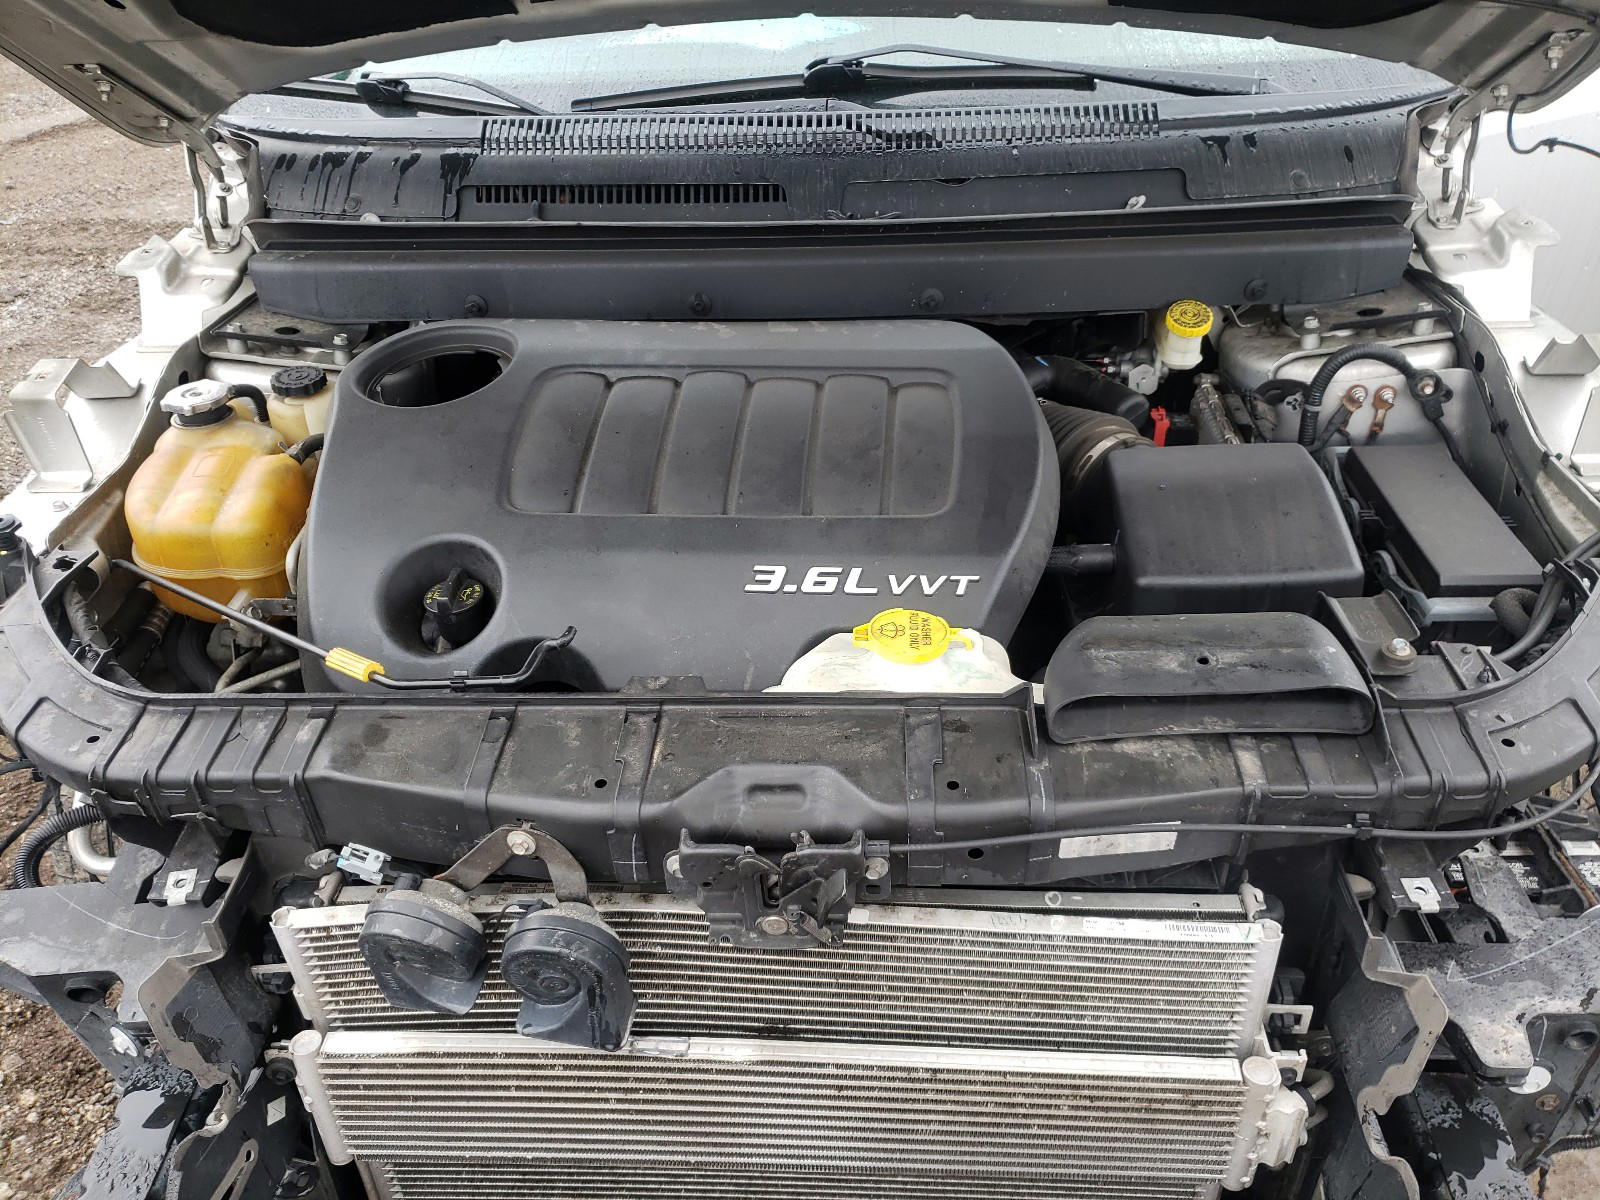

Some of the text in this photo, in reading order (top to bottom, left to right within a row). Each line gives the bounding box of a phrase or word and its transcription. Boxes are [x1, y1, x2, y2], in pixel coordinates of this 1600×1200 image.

[744, 565, 981, 596] 3.6L VVT
[908, 632, 920, 651] ONLY
[920, 616, 932, 647] WASHER
